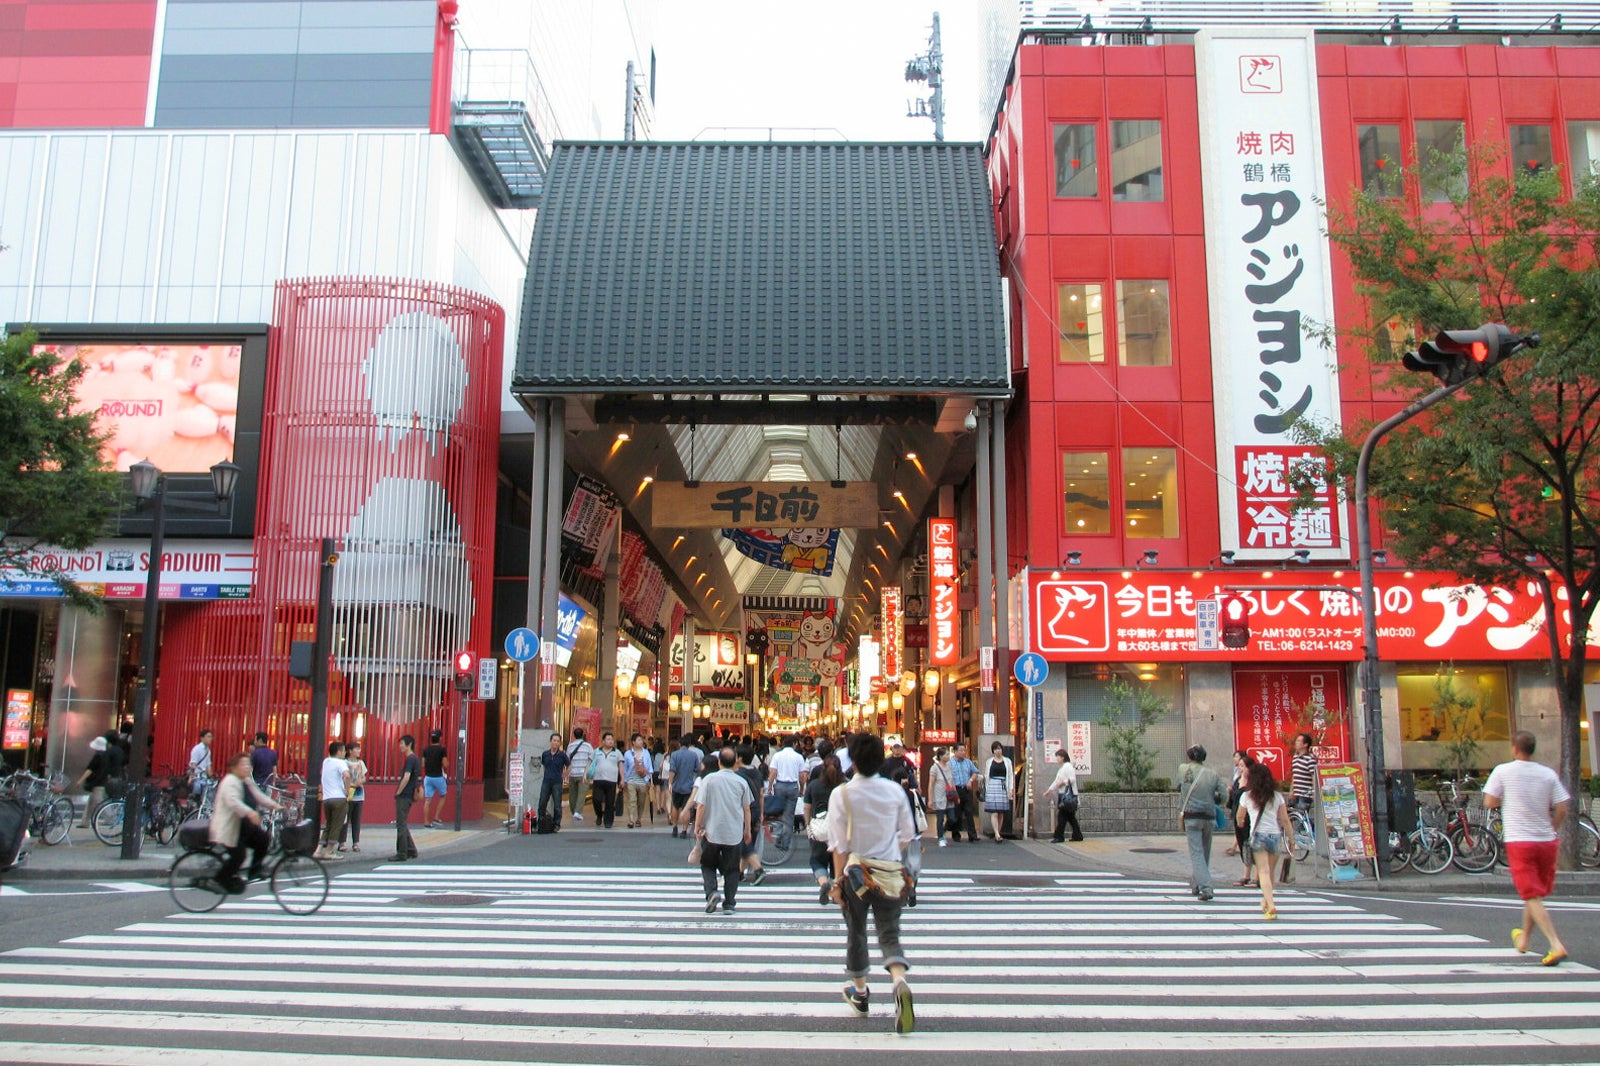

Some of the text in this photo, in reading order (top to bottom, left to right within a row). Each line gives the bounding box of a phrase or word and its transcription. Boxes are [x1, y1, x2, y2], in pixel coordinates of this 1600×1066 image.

[1236, 131, 1295, 155] 焼肉
[1243, 163, 1291, 183] 鶴橋
[1241, 190, 1312, 434] アジヨシ
[1243, 452, 1328, 493] 焼肉
[711, 486, 820, 522] 千日前
[1246, 505, 1333, 548] 冷麺
[139, 552, 221, 572] SADIUM
[711, 668, 744, 690] がんこ
